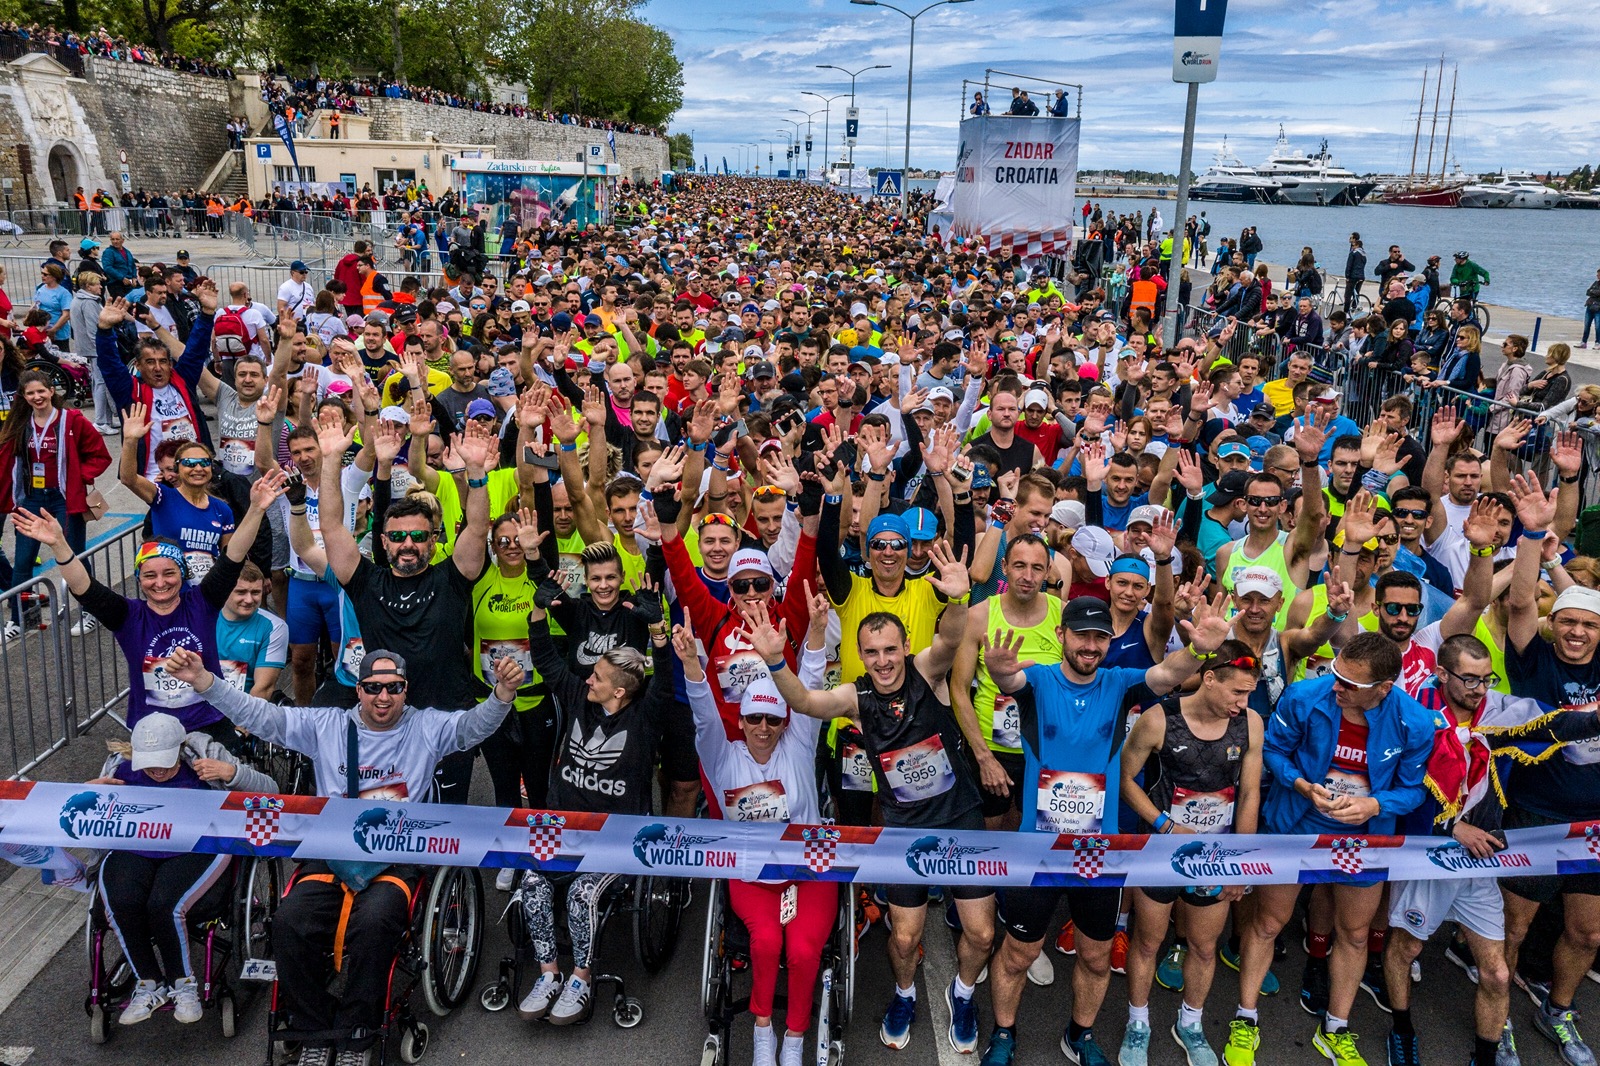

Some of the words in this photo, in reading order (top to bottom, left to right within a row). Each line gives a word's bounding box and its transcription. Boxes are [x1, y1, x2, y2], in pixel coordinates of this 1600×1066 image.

[850, 124, 854, 132] 2
[260, 147, 267, 155] P
[1005, 142, 1054, 160] ZADAR
[996, 167, 1058, 184] CROATIA
[236, 421, 258, 431] GAME
[223, 453, 247, 463] 25167
[180, 527, 221, 545] MIRNA
[186, 540, 213, 551] CROATIA
[494, 601, 516, 612] WORLD
[516, 600, 530, 612] RUN
[588, 631, 618, 654] NIKE
[155, 679, 192, 691] 1392
[562, 765, 626, 797] adidas
[903, 764, 937, 785] 5959
[97, 803, 138, 813] WINGS
[737, 806, 778, 822] 24747
[1049, 798, 1095, 815] 56902
[387, 819, 426, 828] WINGS
[1181, 813, 1224, 827] 34487
[78, 819, 137, 839] WORLD
[137, 822, 173, 840] RUN
[371, 834, 427, 853] WORLD
[427, 836, 460, 855] RUN
[665, 834, 703, 843] WINGS
[650, 848, 704, 867] WORLD
[705, 850, 736, 868] RUN
[1206, 855, 1226, 863] LIFE
[1445, 856, 1501, 869] WORLD
[1498, 853, 1532, 868] RUN
[922, 859, 976, 875] WORLD
[977, 860, 1008, 876] RUN
[1187, 862, 1242, 877] WORLD
[1241, 862, 1274, 875] RUN
